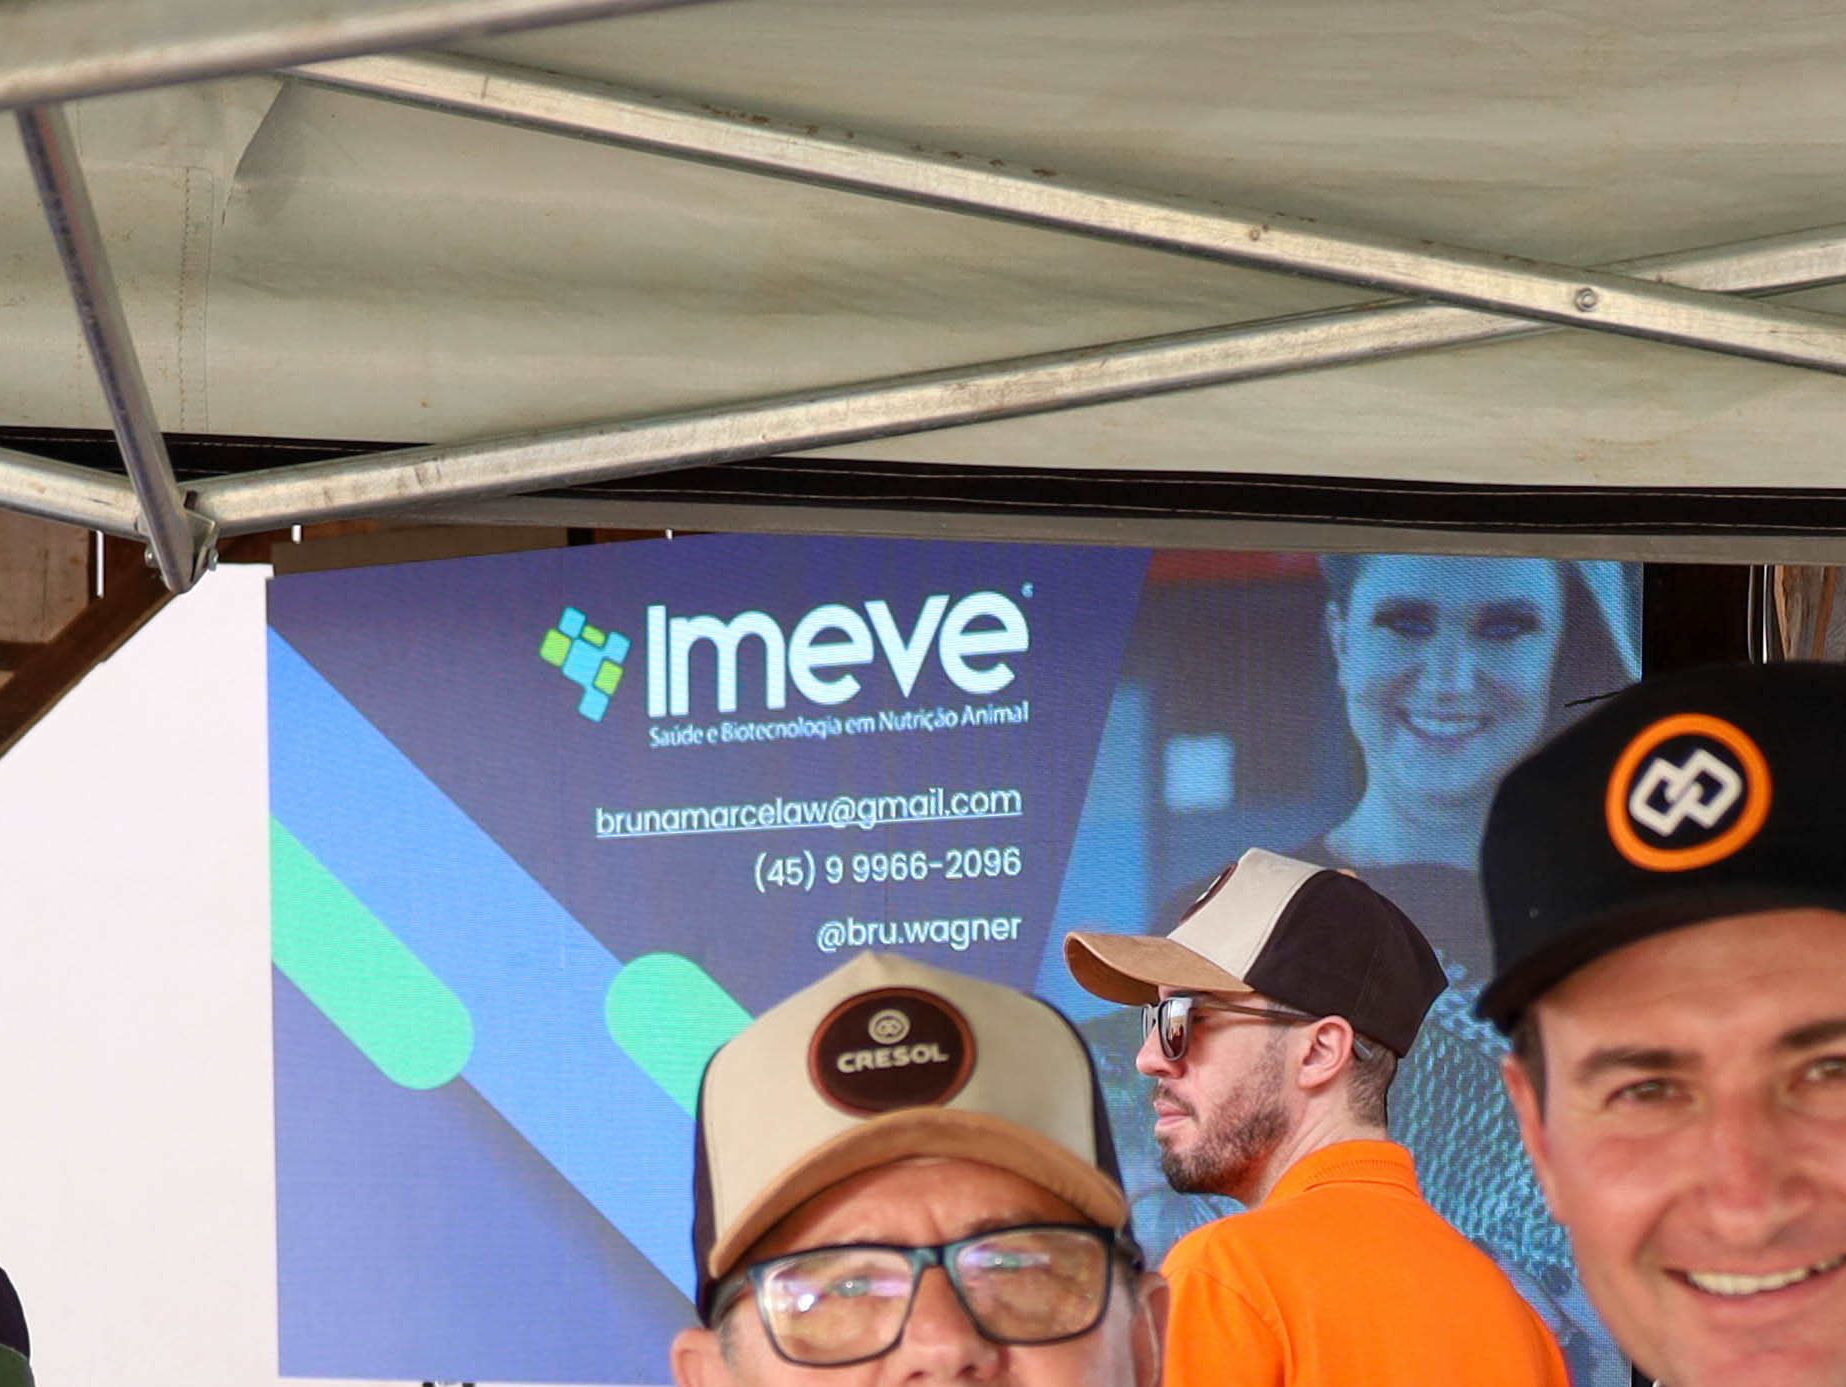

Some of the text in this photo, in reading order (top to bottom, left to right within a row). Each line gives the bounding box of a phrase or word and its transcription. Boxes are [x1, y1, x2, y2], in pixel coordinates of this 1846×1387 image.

[647, 591, 1029, 717] Imeve
[649, 700, 1029, 748] Saúde e Biotecnologia em Nutrição Animal
[596, 788, 1022, 835] brunamarcelaw@gmail.com
[755, 847, 1022, 892] (45) 9 9966-2096
[817, 916, 1022, 952] @bru.wagner
[837, 1043, 950, 1073] CRESOL
